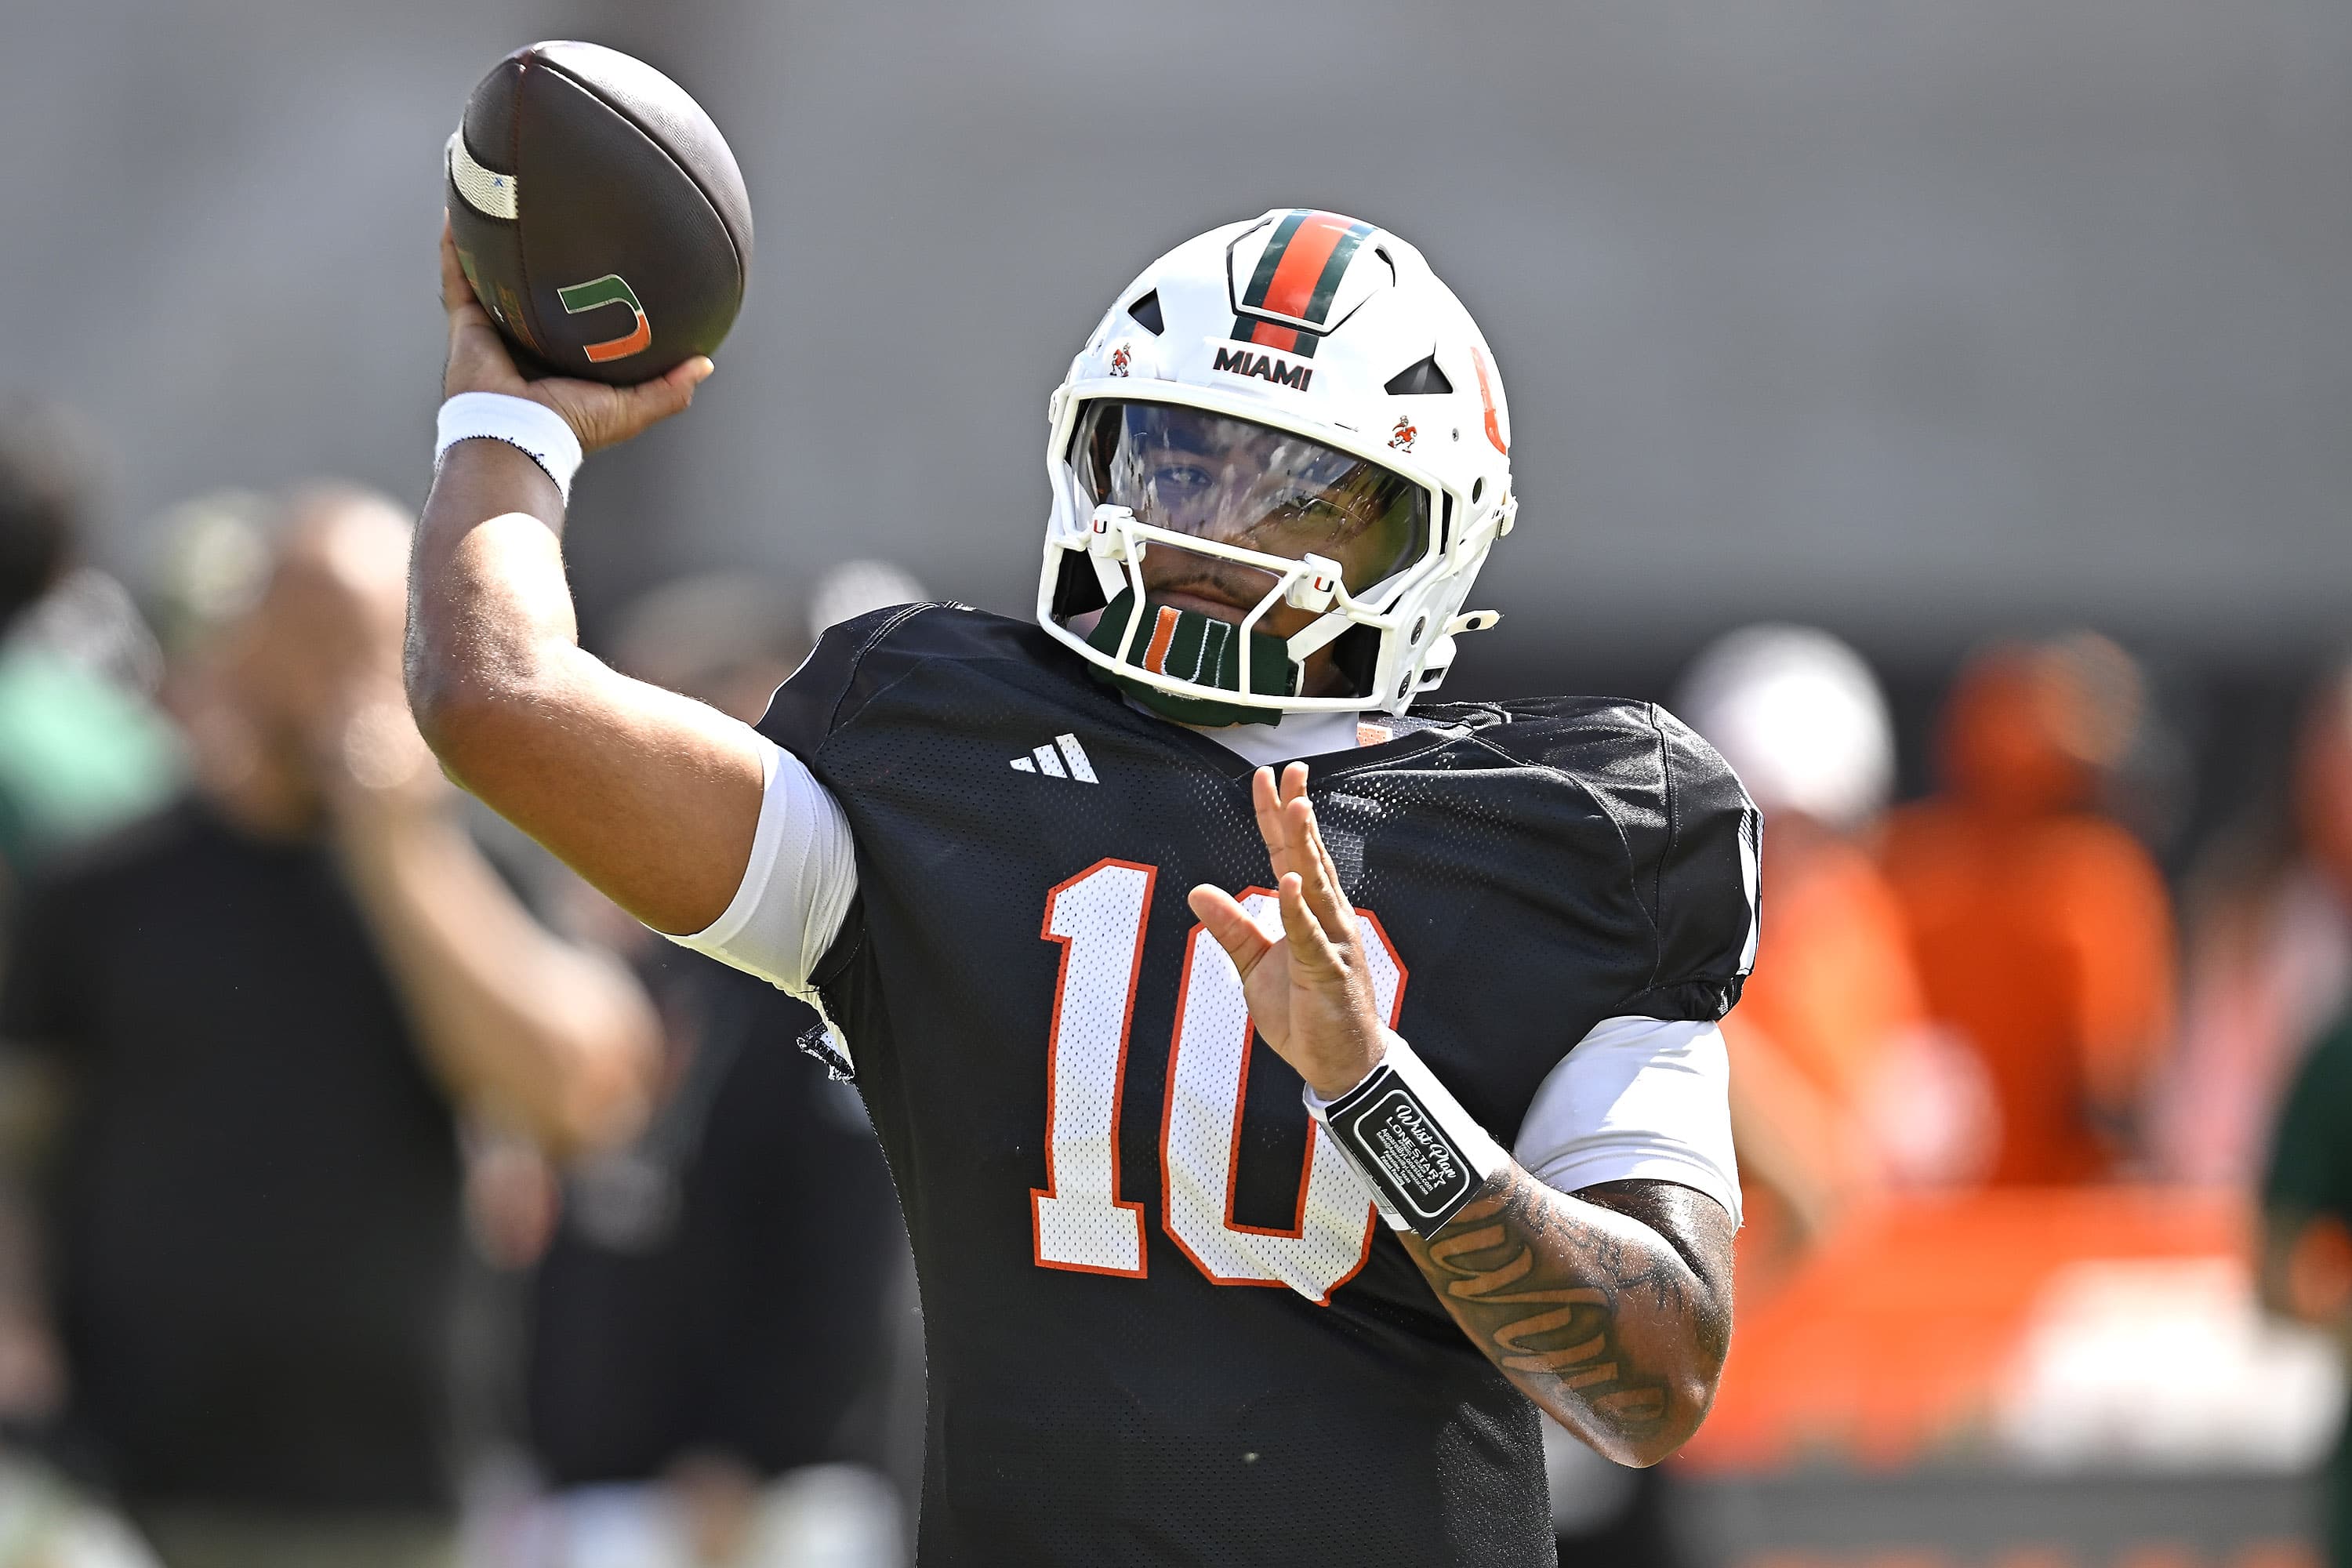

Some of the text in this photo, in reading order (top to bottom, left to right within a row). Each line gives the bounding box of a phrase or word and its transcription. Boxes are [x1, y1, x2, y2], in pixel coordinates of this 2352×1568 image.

[557, 274, 652, 363] U
[1213, 347, 1313, 392] MIAMI
[1094, 519, 1108, 534] U
[1313, 576, 1334, 592] U
[1142, 605, 1231, 699] U
[1029, 857, 1409, 1306] 10
[1381, 1128, 1435, 1191] ApparelByLonestar.com
[1396, 1105, 1456, 1178] Wrist Plan
